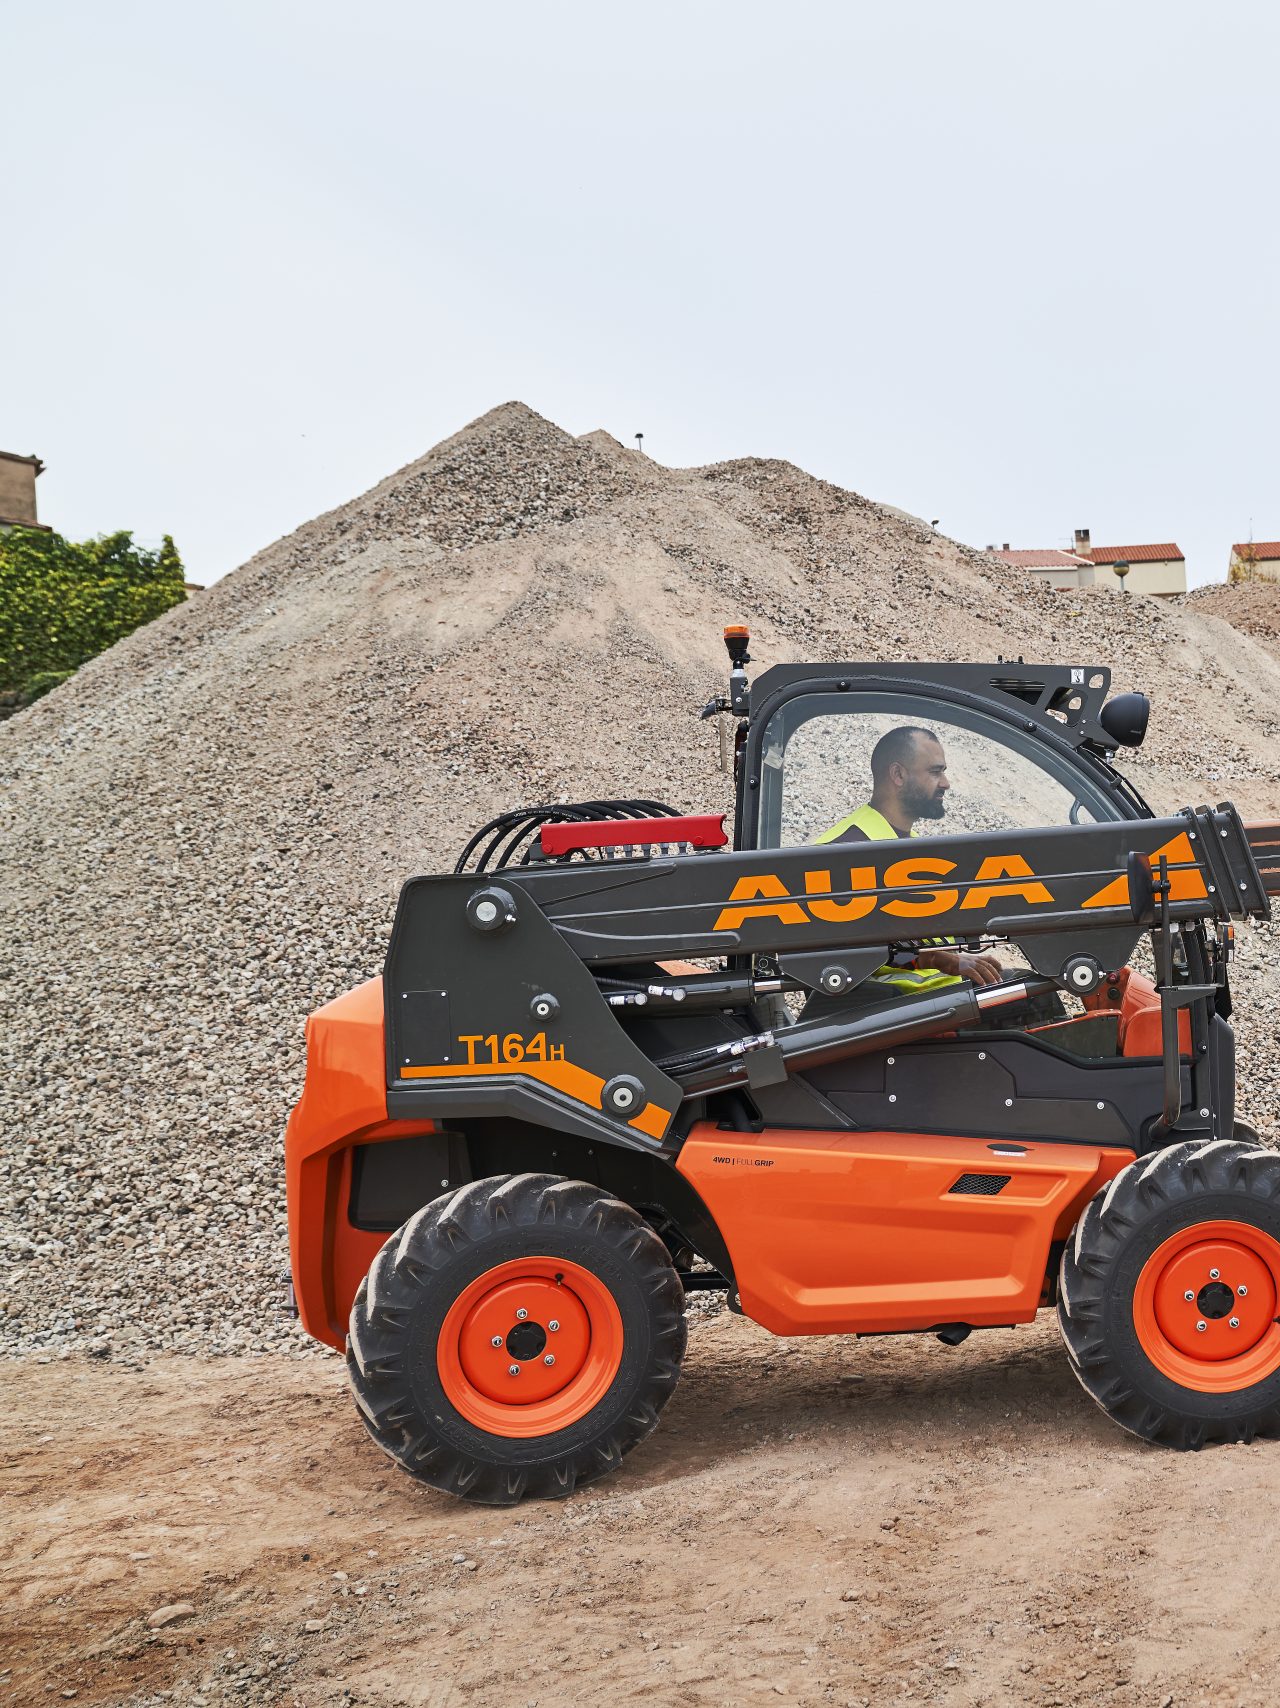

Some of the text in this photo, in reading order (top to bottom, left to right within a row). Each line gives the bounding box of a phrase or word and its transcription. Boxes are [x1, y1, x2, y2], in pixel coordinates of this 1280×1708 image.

[713, 854, 1055, 931] AUSA
[458, 1032, 565, 1064] T164H
[713, 1156, 731, 1164] 4WD
